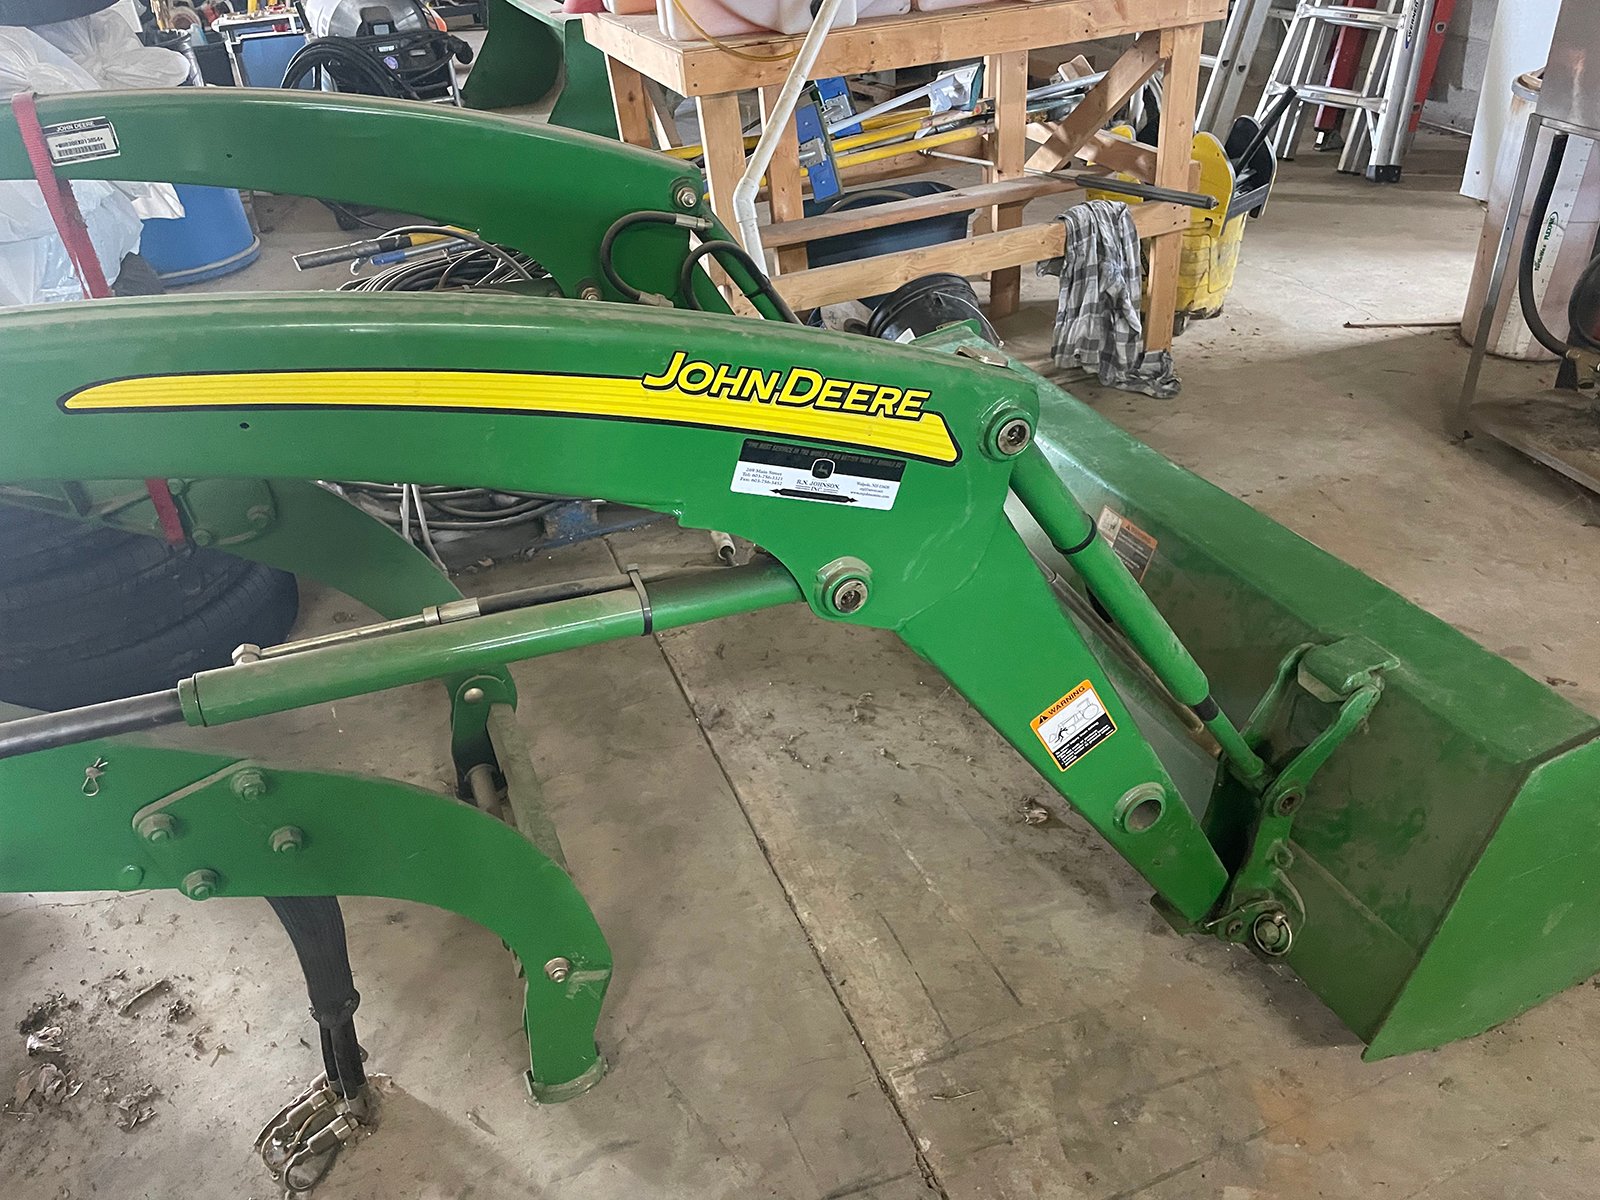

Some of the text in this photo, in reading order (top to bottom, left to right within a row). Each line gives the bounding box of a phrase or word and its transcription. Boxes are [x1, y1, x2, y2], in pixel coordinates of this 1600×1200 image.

[75, 121, 94, 129] DEERE
[642, 351, 932, 420] JOHN DEERE
[809, 481, 840, 490] JOHNSON
[1048, 685, 1086, 715] WARNING
